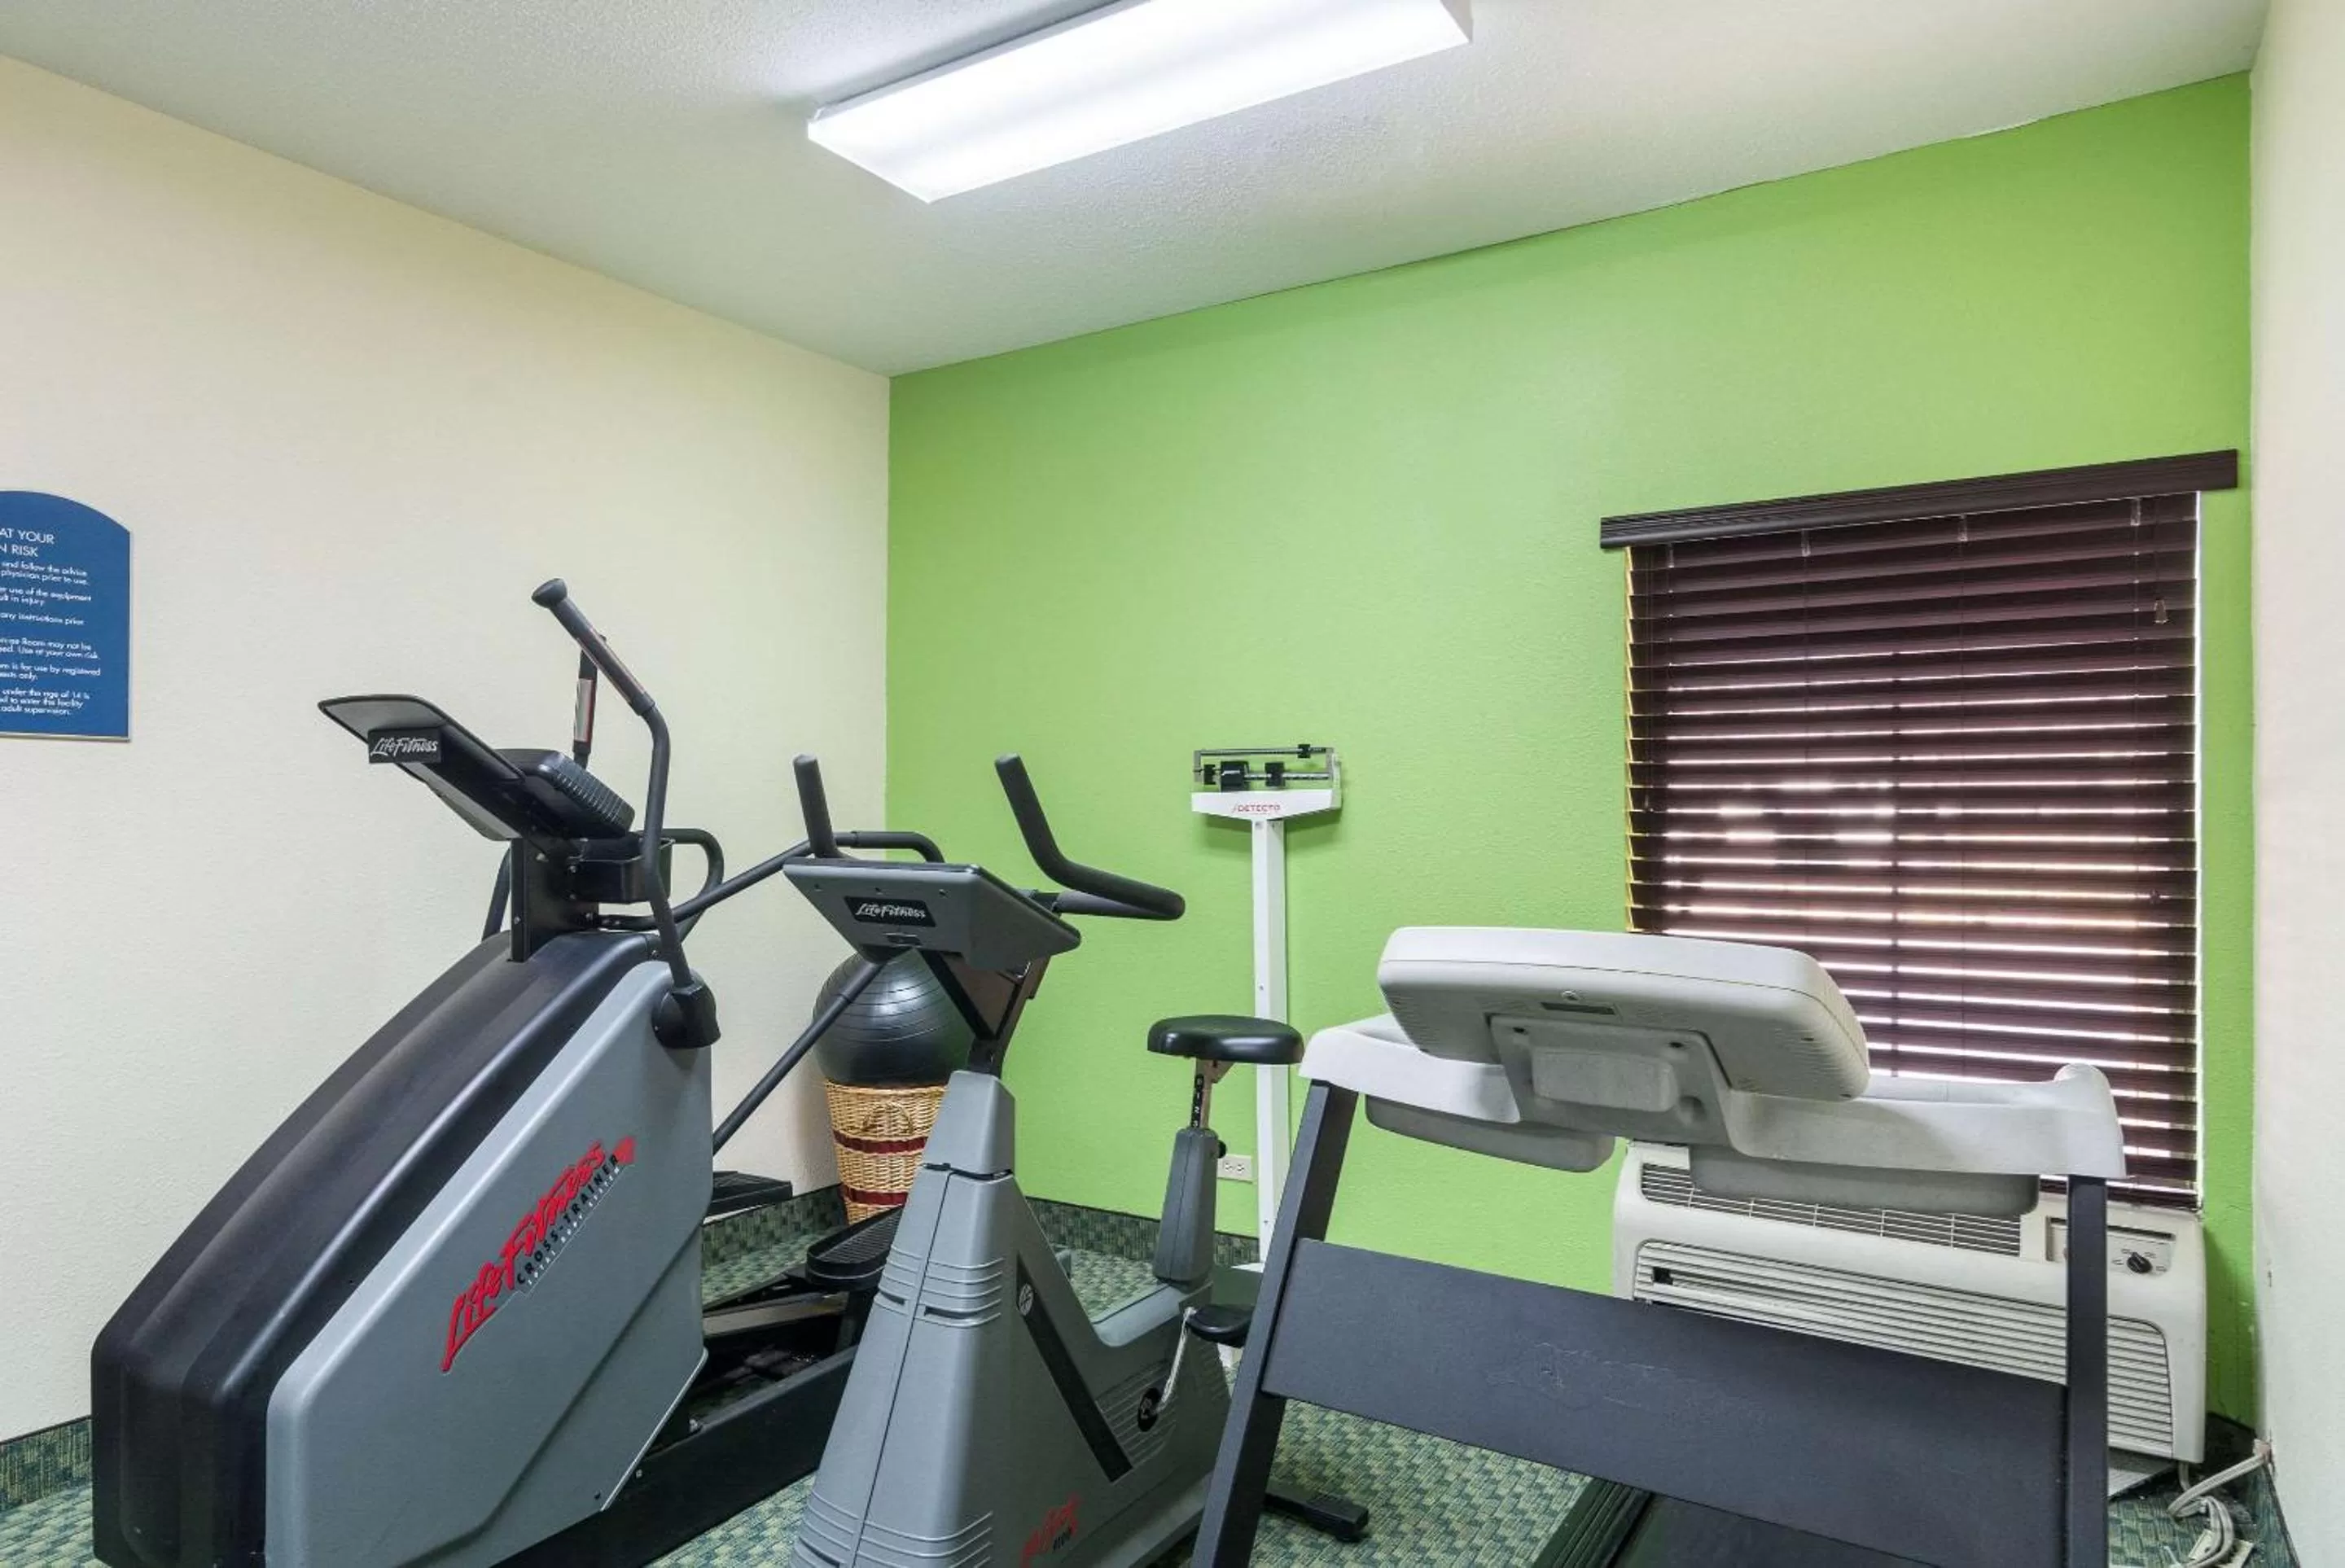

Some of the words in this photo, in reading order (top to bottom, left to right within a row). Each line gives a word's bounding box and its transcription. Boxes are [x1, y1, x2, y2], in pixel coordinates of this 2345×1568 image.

[0, 528, 14, 538] AT
[17, 530, 55, 545] YOUR
[11, 544, 39, 558] RISK
[10, 595, 20, 603] in
[25, 587, 35, 596] of
[35, 589, 49, 598] the
[21, 637, 46, 647] Room
[47, 641, 65, 650] may
[20, 662, 33, 672] for
[33, 665, 49, 673] use
[49, 664, 60, 675] by
[1233, 804, 1281, 812] DETECTO
[517, 1154, 619, 1284] CROSS-TRAINER
